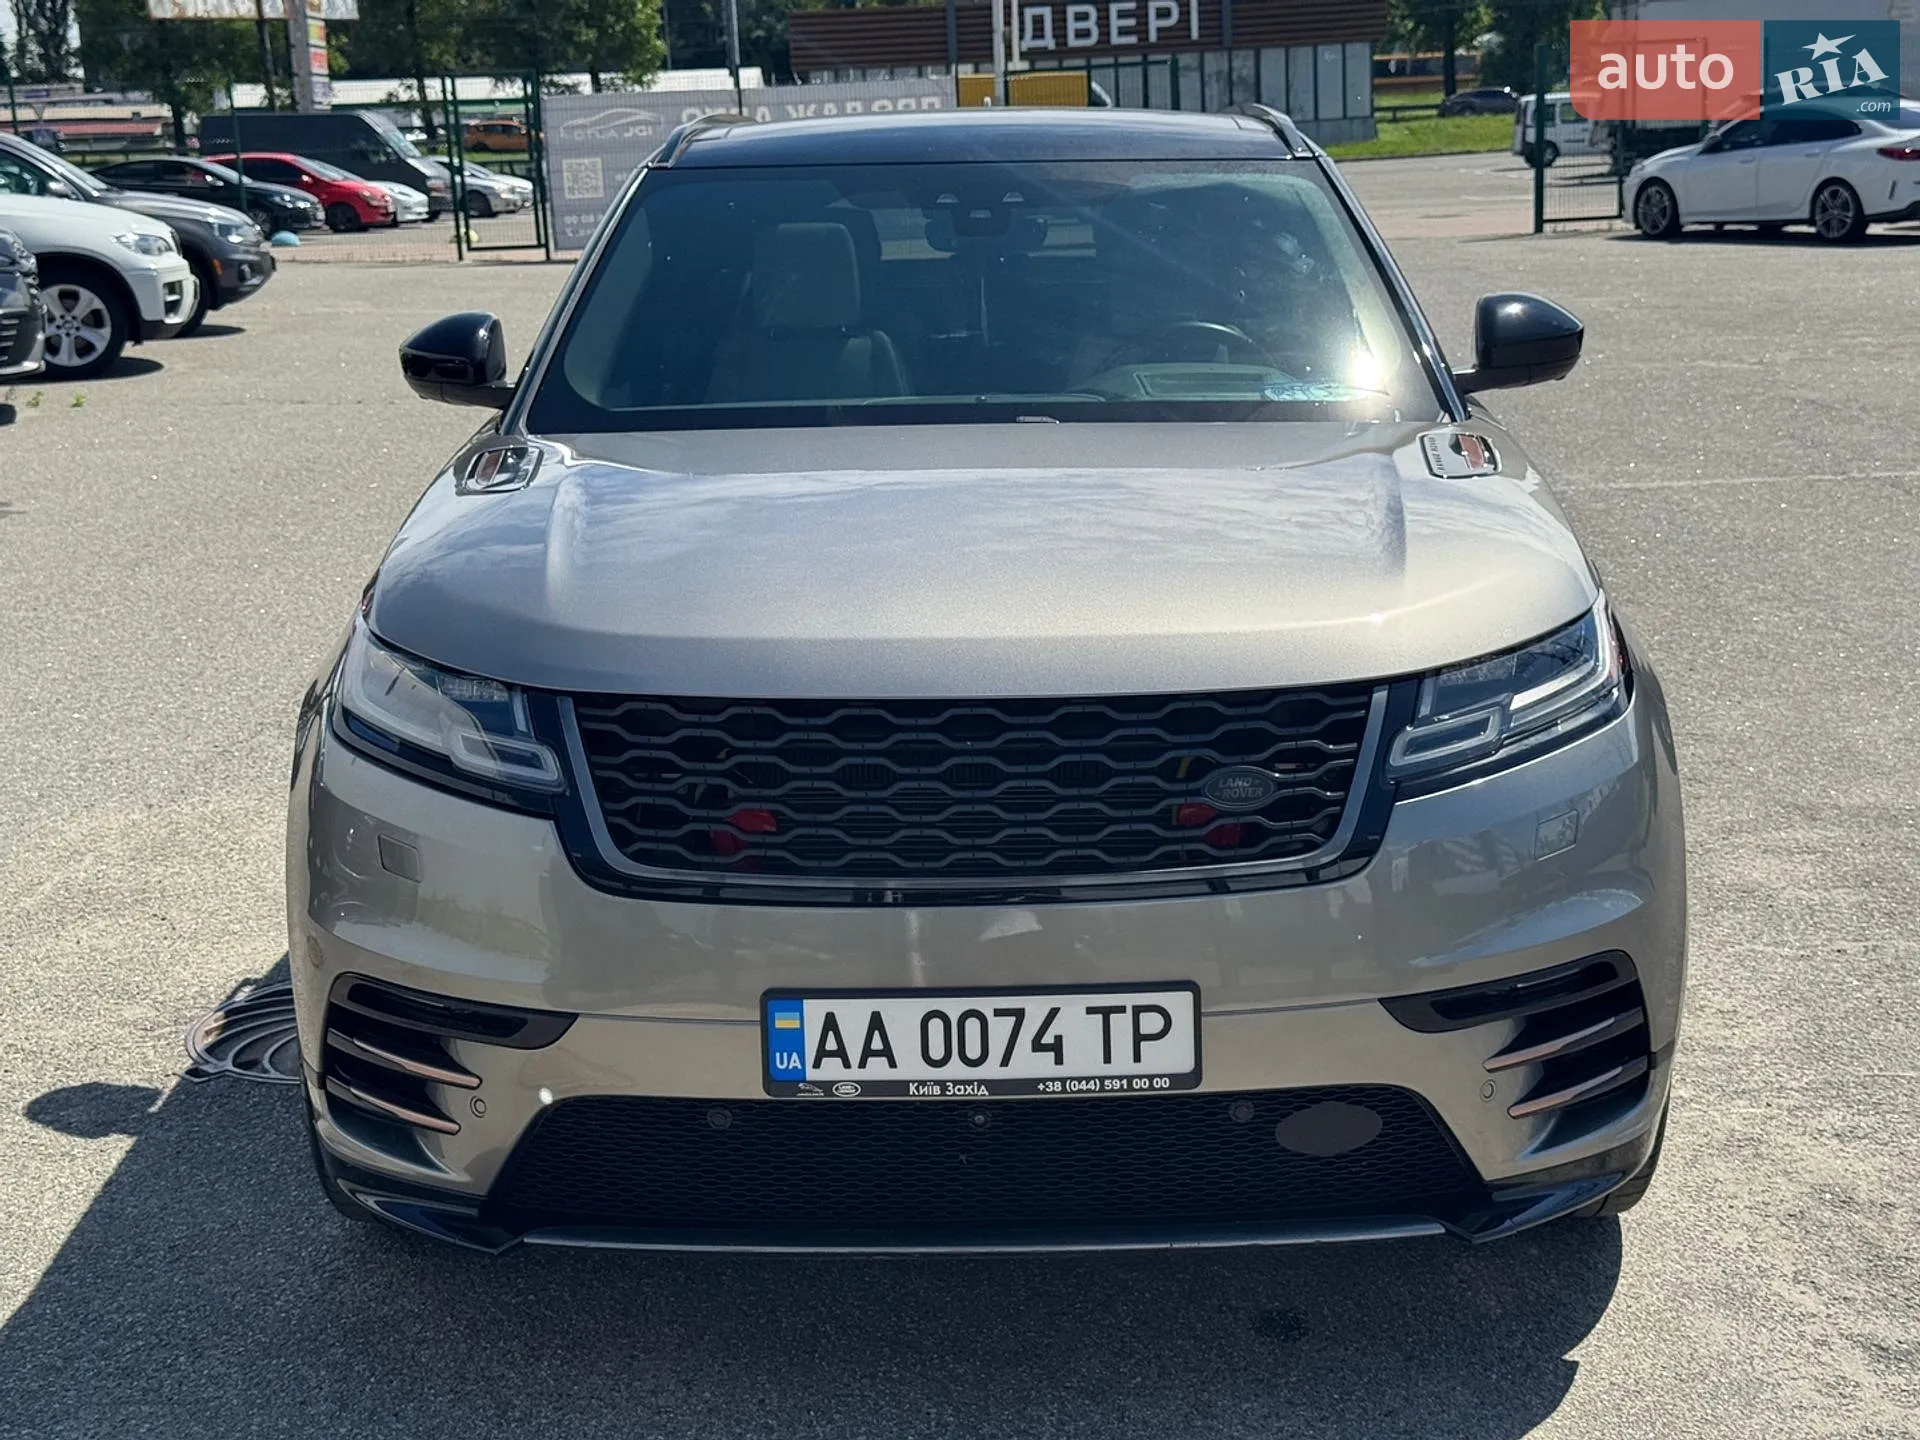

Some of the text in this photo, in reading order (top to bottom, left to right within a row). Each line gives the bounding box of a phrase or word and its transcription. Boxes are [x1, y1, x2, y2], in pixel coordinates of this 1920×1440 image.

[1020, 0, 1199, 51] ДВЕРІ
[1219, 776, 1252, 789] LAND
[1222, 786, 1264, 799] ROVER
[812, 1004, 1172, 1069] AA 0074 TP
[775, 1052, 802, 1070] UA
[909, 1081, 989, 1096] Київ Захід
[1037, 1077, 1170, 1093] +38 (044) 591 00 00
